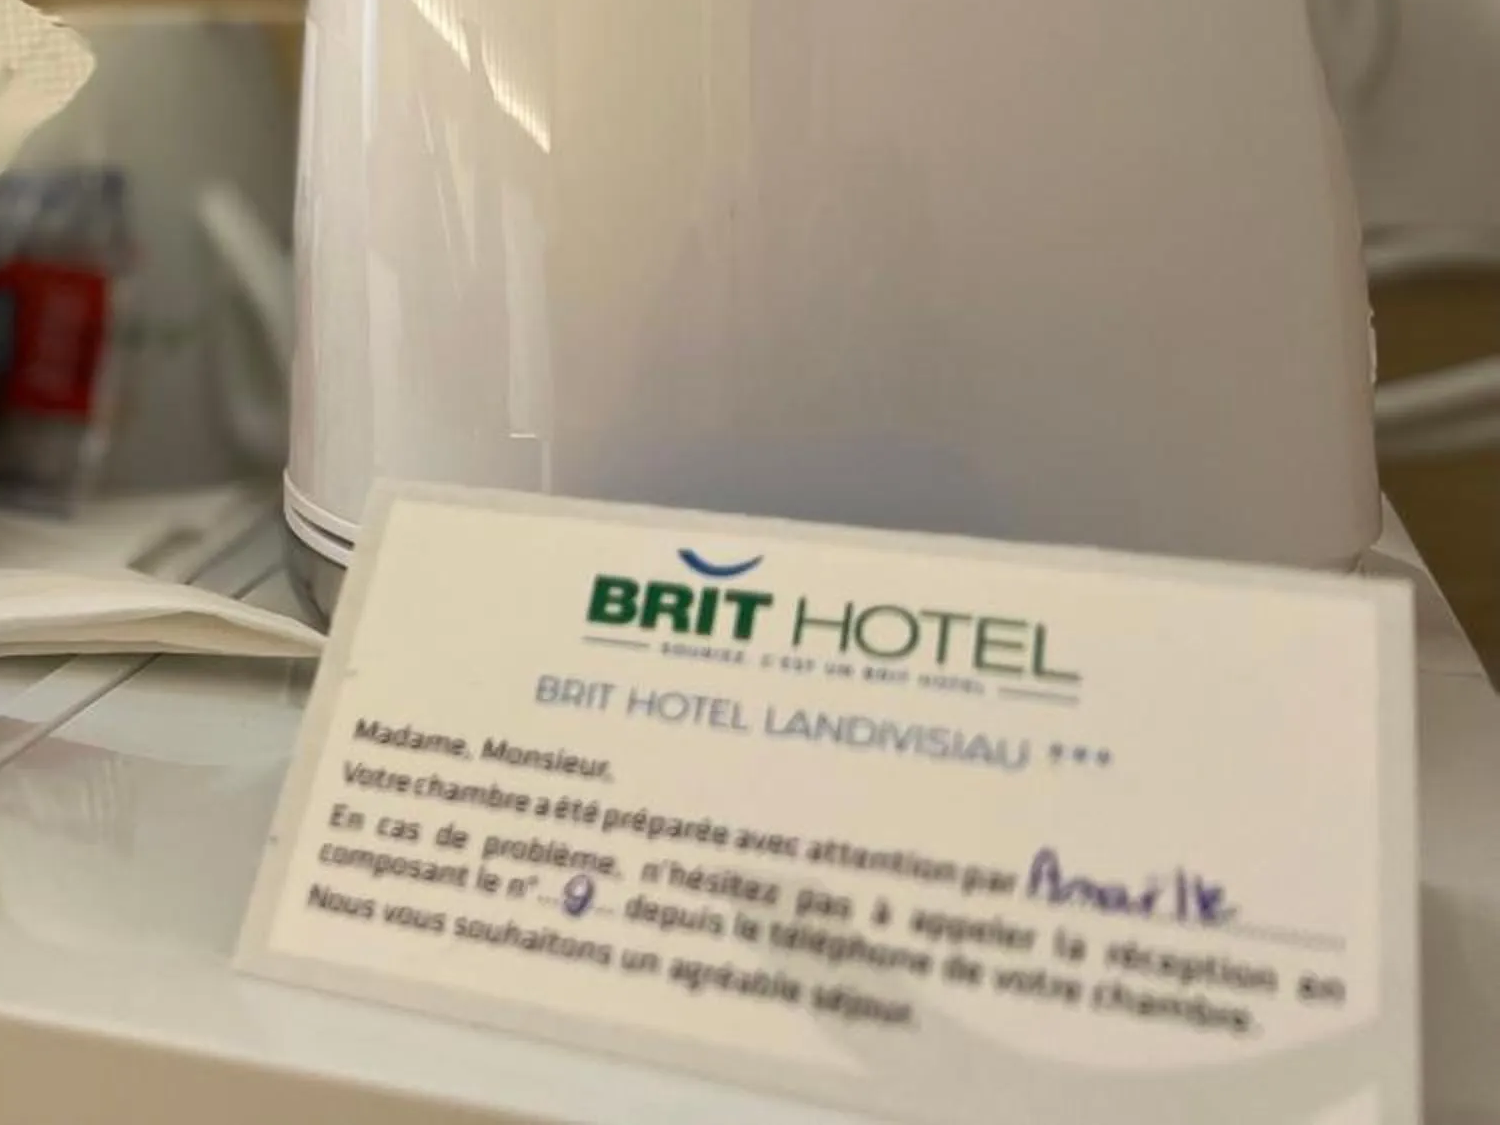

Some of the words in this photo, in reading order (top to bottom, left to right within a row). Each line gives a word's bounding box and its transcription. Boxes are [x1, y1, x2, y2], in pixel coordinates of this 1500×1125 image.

[585, 574, 774, 641] BRIT
[790, 595, 1083, 684] HOTEL
[534, 674, 616, 710] BRIT
[625, 687, 750, 732] HOTEL
[764, 706, 1030, 772] LANDIVISIAU
[318, 841, 469, 889] composant
[475, 866, 499, 894] le
[343, 761, 411, 795] Votre
[412, 773, 531, 815] chambre
[534, 796, 550, 817] a
[553, 795, 598, 825] été
[601, 805, 729, 846] préparée
[734, 826, 800, 858] avec
[805, 838, 958, 886] attention
[961, 864, 1019, 899] par
[307, 883, 375, 920] Nous
[383, 903, 446, 934] vous
[453, 913, 611, 966] souhaitons
[620, 945, 659, 975] un
[668, 954, 801, 1004] agréable
[328, 803, 365, 830] En
[377, 813, 421, 842] cas
[435, 821, 469, 850] de
[795, 887, 853, 923] pas
[870, 895, 891, 927] à
[909, 906, 1037, 954] appeler
[1052, 925, 1086, 962] la
[1104, 939, 1279, 996] réception
[1296, 973, 1347, 1005] en
[560, 873, 596, 919] 9
[624, 895, 724, 937] depuis
[734, 911, 758, 941] le
[769, 917, 934, 976] téléphone
[942, 951, 984, 987] de
[992, 963, 1083, 1005] votre
